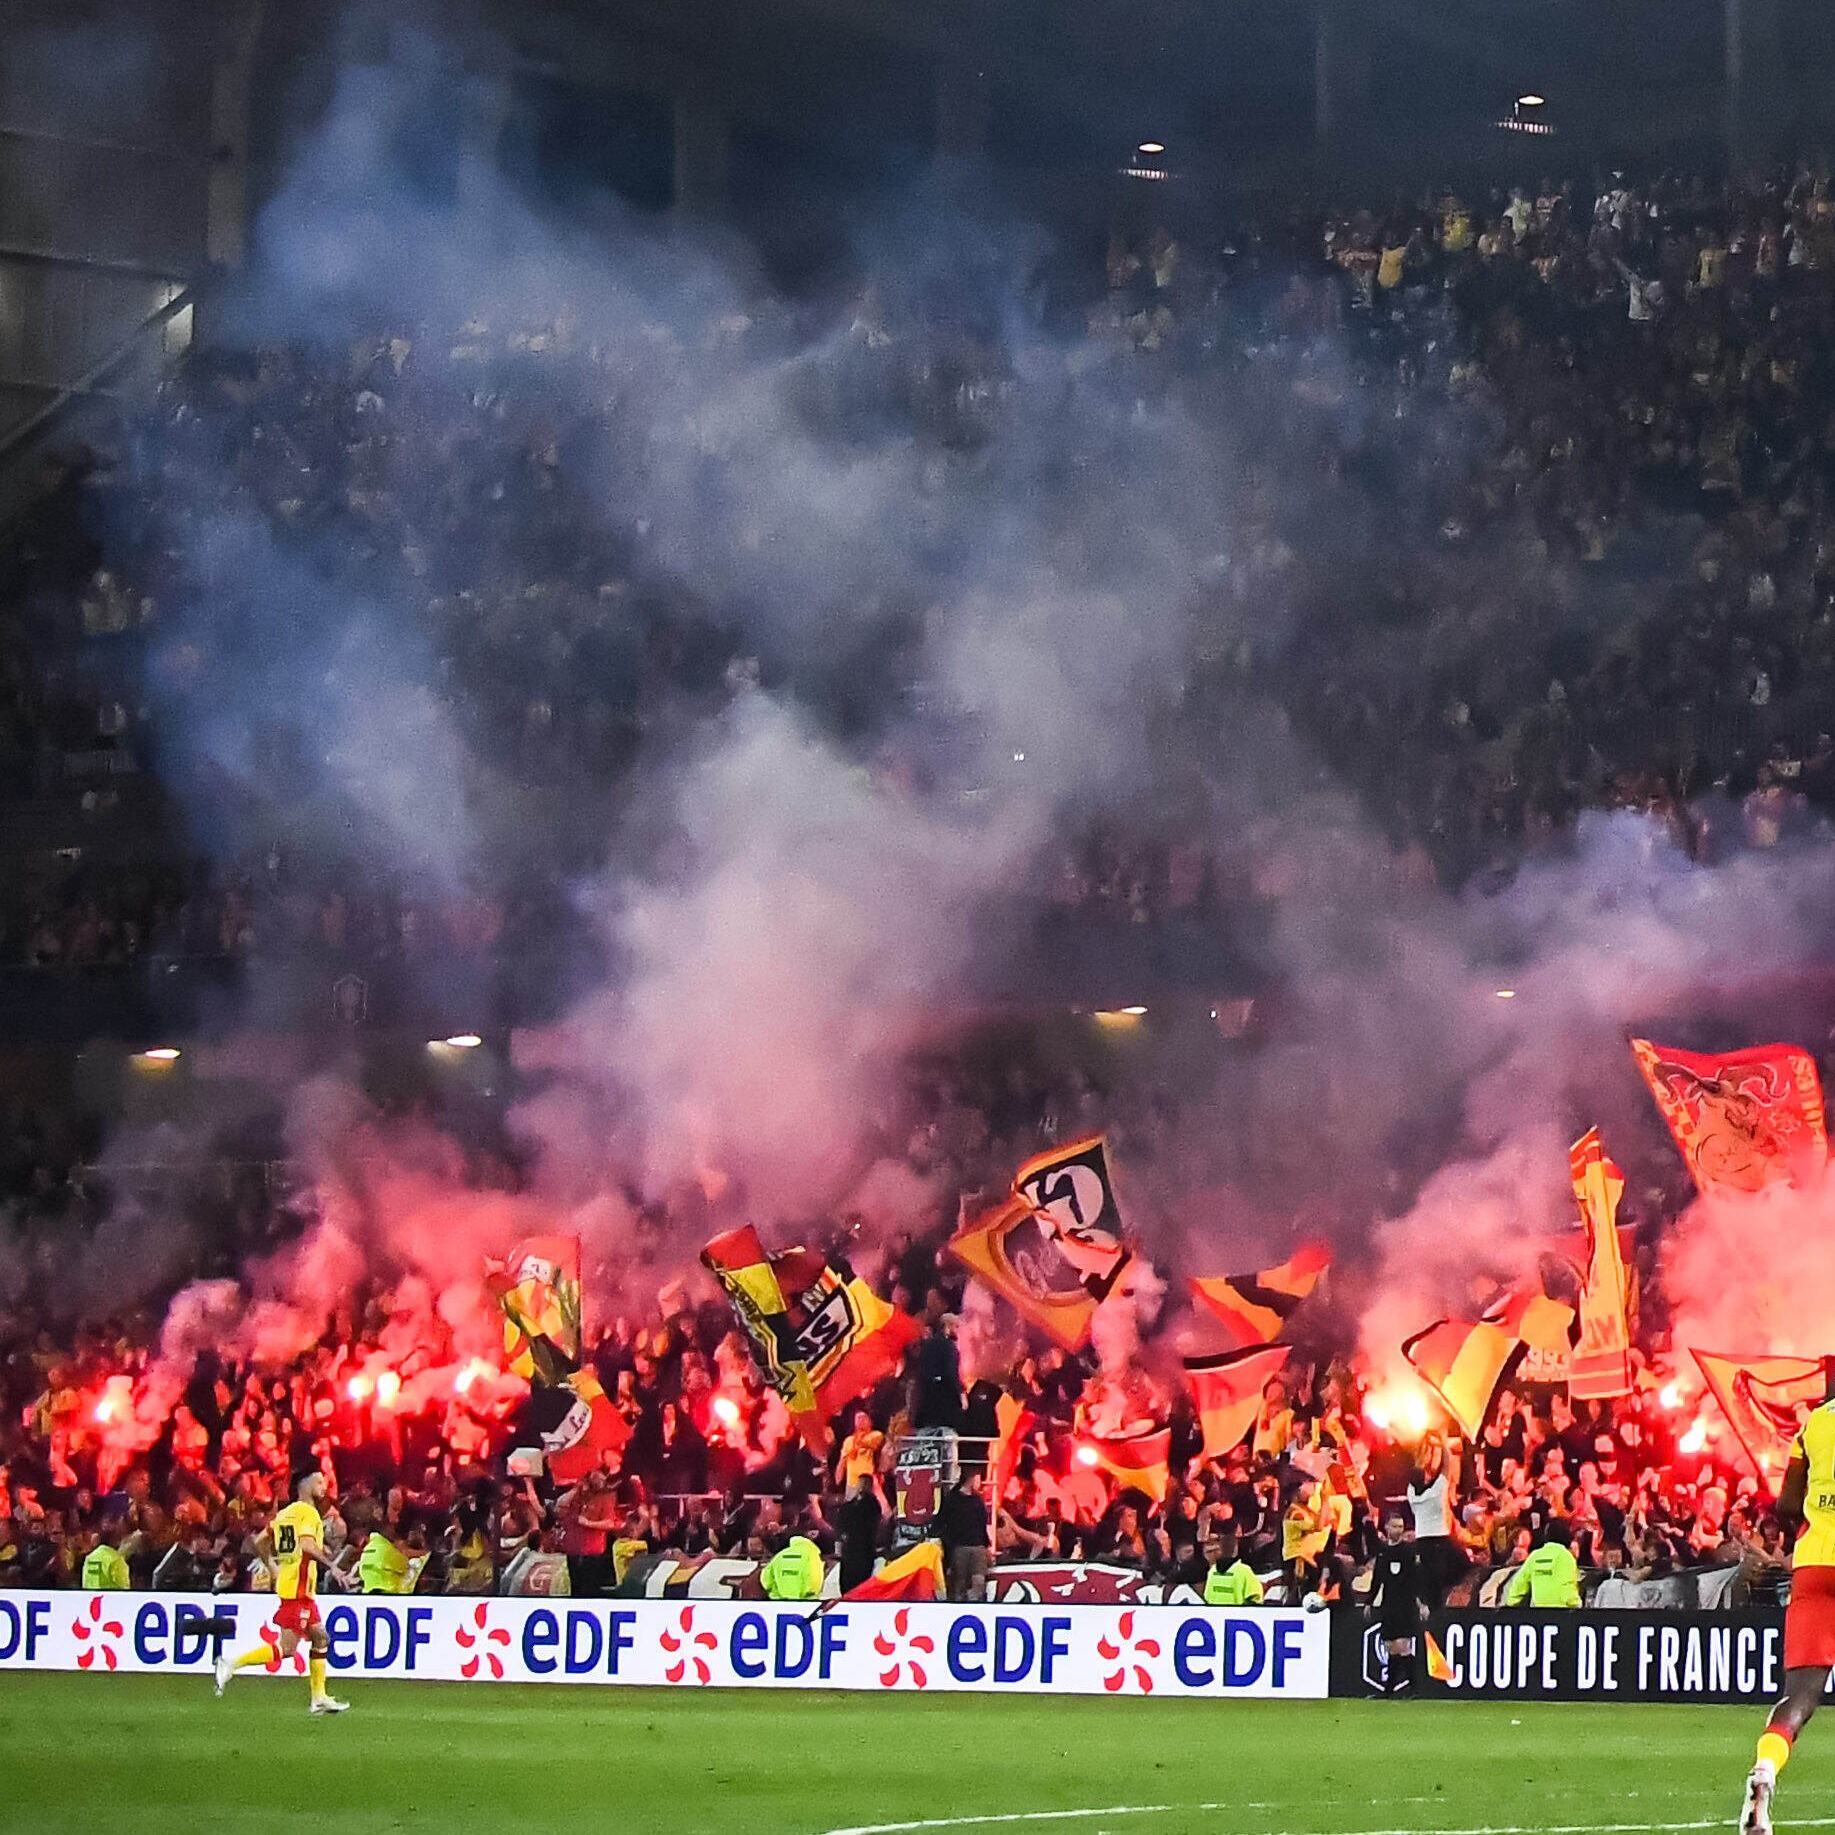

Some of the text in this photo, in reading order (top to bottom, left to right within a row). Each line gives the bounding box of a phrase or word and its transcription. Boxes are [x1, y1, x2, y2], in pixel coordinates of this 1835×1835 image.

[1445, 1623, 1581, 1689] COUPE
[1592, 1624, 1625, 1691] DE
[1638, 1625, 1779, 1694] FRANCE
